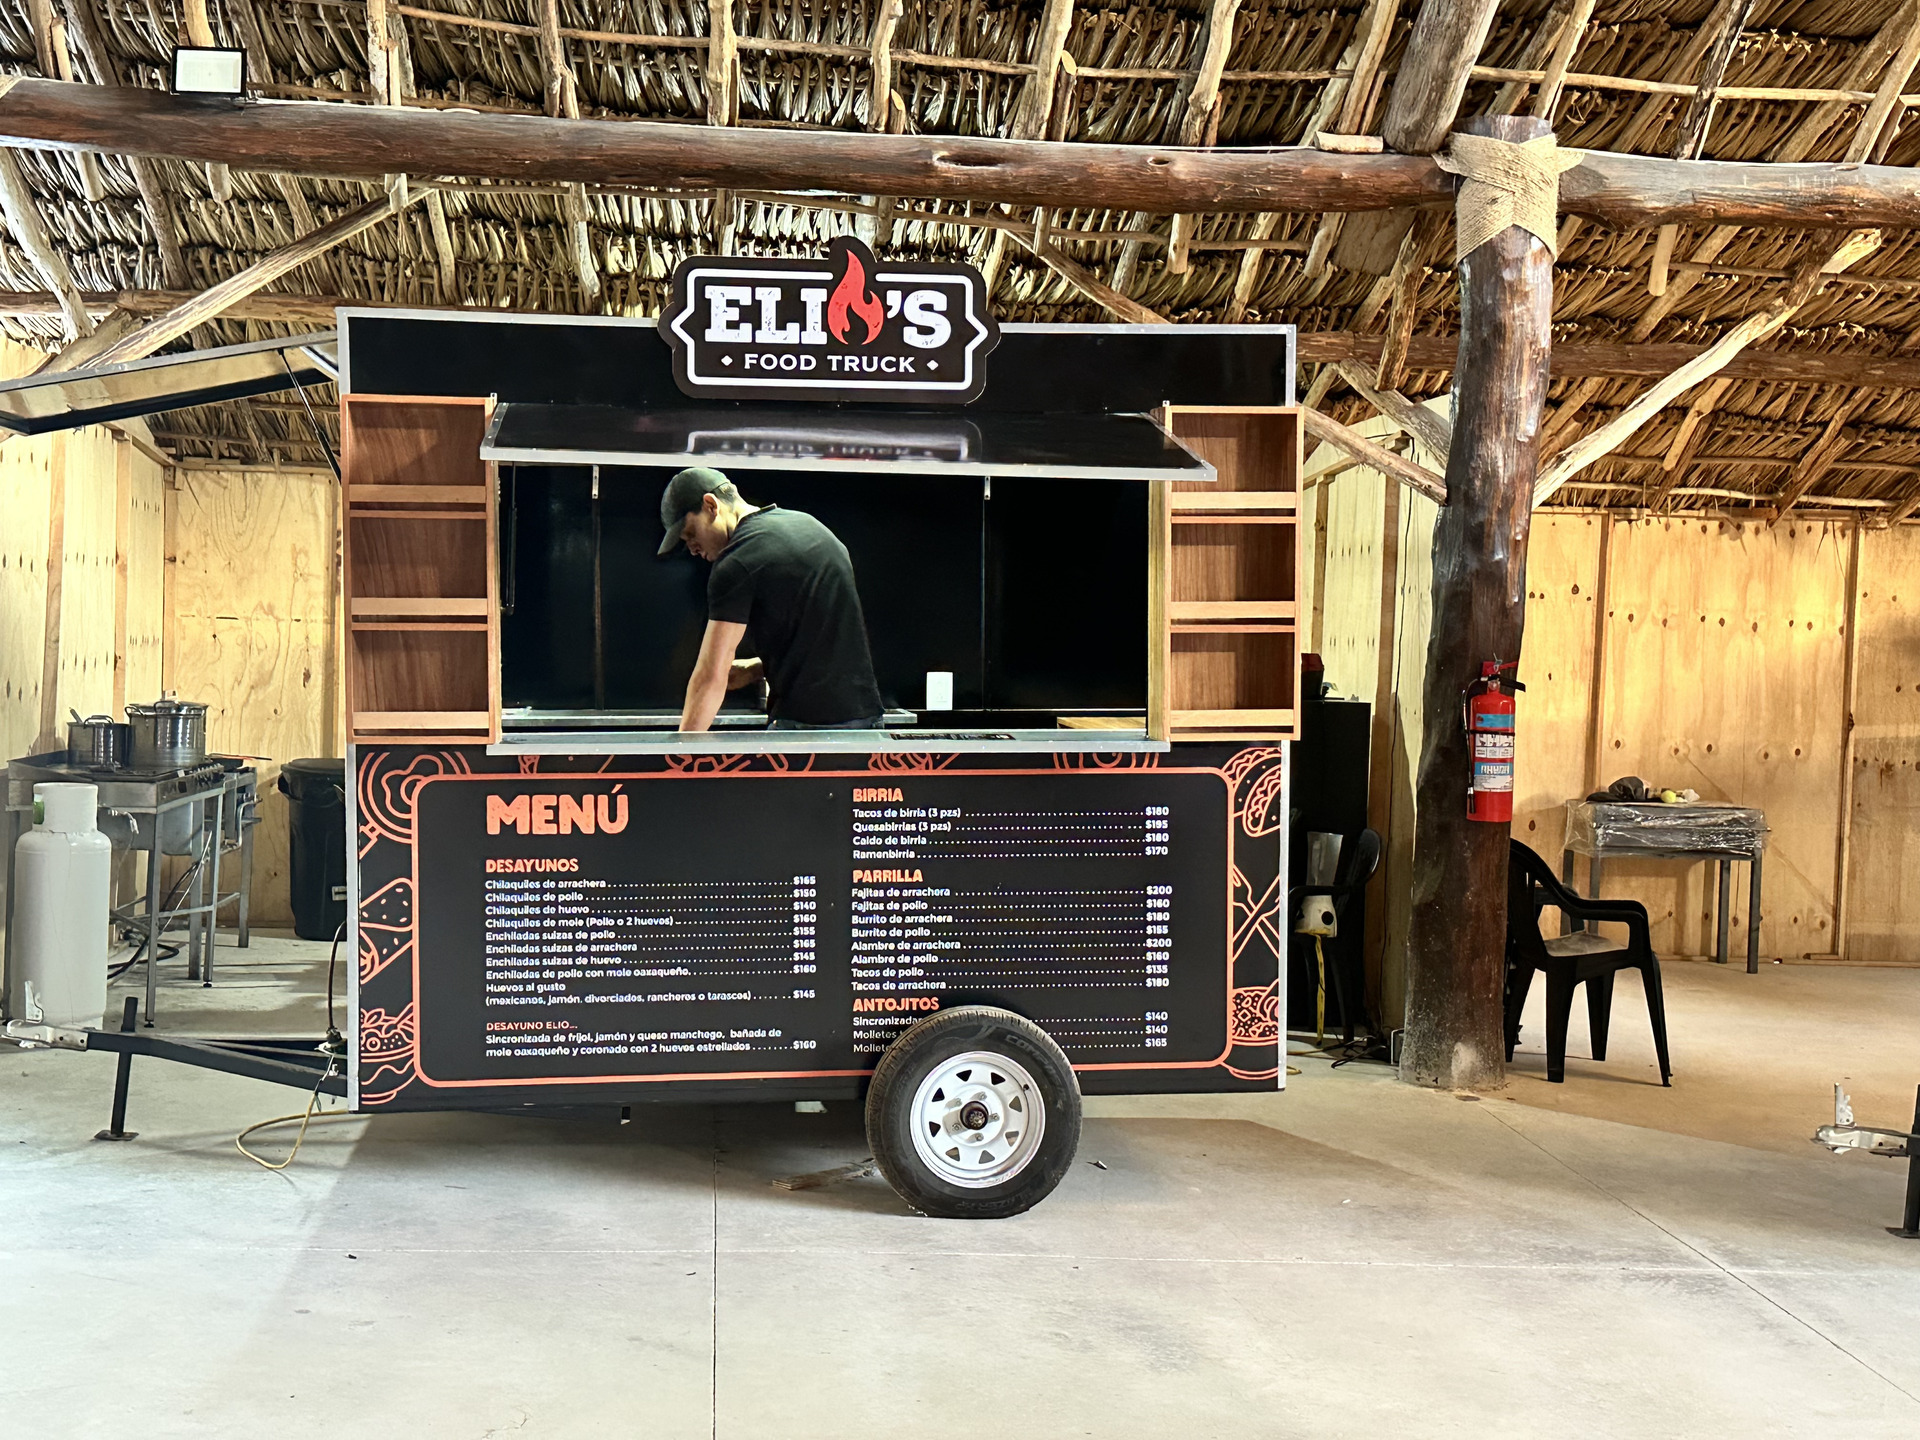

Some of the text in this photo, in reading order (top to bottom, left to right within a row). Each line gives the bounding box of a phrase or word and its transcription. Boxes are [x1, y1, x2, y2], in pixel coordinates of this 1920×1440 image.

[744, 353, 915, 373] FOOD TRUCK
[853, 788, 904, 802] BIRRIA
[486, 784, 629, 835] MENÚ
[852, 809, 882, 817] Tacos
[884, 808, 898, 817] de
[899, 808, 926, 817] birria
[940, 808, 961, 818] pzs)
[852, 822, 917, 832] Quesabirrias
[930, 822, 952, 832] pzs)
[852, 836, 883, 845] Caldo
[884, 836, 899, 845] de
[900, 835, 927, 845] birria
[852, 849, 916, 859] Ramenbirria
[485, 858, 579, 873] DESAYUNOS
[852, 869, 924, 884] PARRILLA
[485, 880, 541, 890] Chilaquiles
[542, 880, 556, 888] de
[558, 879, 606, 888] arrachera
[485, 892, 541, 903] Chilaquiles
[542, 892, 556, 901] de
[558, 892, 584, 902] pollo
[851, 888, 885, 899] Fajitas
[886, 887, 900, 897] de
[901, 887, 951, 896] arrachera
[485, 905, 541, 916] Chilaquiles
[542, 905, 556, 914] de
[558, 905, 590, 914] huevo
[851, 901, 885, 912] Fajitas
[886, 901, 900, 910] de
[902, 901, 928, 911] pollo
[485, 918, 541, 929] Chilaquiles
[542, 918, 556, 927] de
[558, 918, 584, 926] mole
[586, 917, 615, 927] (Pollo
[626, 917, 633, 925] 2
[634, 916, 674, 926] huevos)
[851, 914, 887, 924] Burrito
[889, 914, 903, 923] de
[904, 914, 953, 923] arrachera
[485, 931, 540, 941] Enchiladas
[542, 931, 573, 939] suizas
[575, 931, 589, 939] de
[590, 930, 616, 940] pollo
[851, 928, 887, 937] Burrito
[889, 927, 903, 936] de
[904, 927, 931, 938] pollo
[485, 944, 540, 953] Enchiladas
[542, 943, 573, 953] suizas
[575, 943, 589, 952] de
[590, 943, 638, 952] arrachera
[851, 941, 895, 950] Alambre
[897, 941, 911, 950] de
[912, 940, 961, 949] arrachera
[485, 957, 540, 966] Enchiladas
[542, 956, 573, 965] suizas
[575, 956, 589, 965] de
[590, 956, 622, 964] huevo
[851, 954, 895, 964] Alambre
[897, 954, 911, 963] de
[912, 954, 939, 965] pollo
[485, 970, 540, 979] Enchiladas
[542, 969, 555, 978] de
[557, 969, 583, 979] pollo
[606, 968, 632, 977] mole
[851, 968, 881, 977] Tacos
[882, 968, 896, 977] de
[898, 967, 924, 978] pollo
[485, 983, 566, 993] Huevos al gusto
[851, 982, 881, 990] Tacos
[882, 981, 896, 990] de
[898, 980, 947, 990] arrachera
[647, 993, 696, 1001] rancheros
[707, 991, 752, 1000] tarascos)
[853, 997, 940, 1012] ANTOJITOS
[486, 1022, 544, 1031] DESAYUNO
[485, 1034, 551, 1044] Sincronizada
[552, 1033, 566, 1042] de
[594, 1032, 627, 1043] jamón
[629, 1033, 636, 1042] y
[637, 1033, 668, 1041] queso
[730, 1029, 767, 1038] bañada
[768, 1029, 782, 1038] de
[853, 1030, 897, 1039] Molletes
[485, 1048, 512, 1056] mole
[572, 1048, 579, 1056] y
[580, 1045, 628, 1054] coronado
[650, 1044, 658, 1052] 2
[659, 1044, 695, 1052] huevos
[696, 1042, 750, 1051] estrellados
